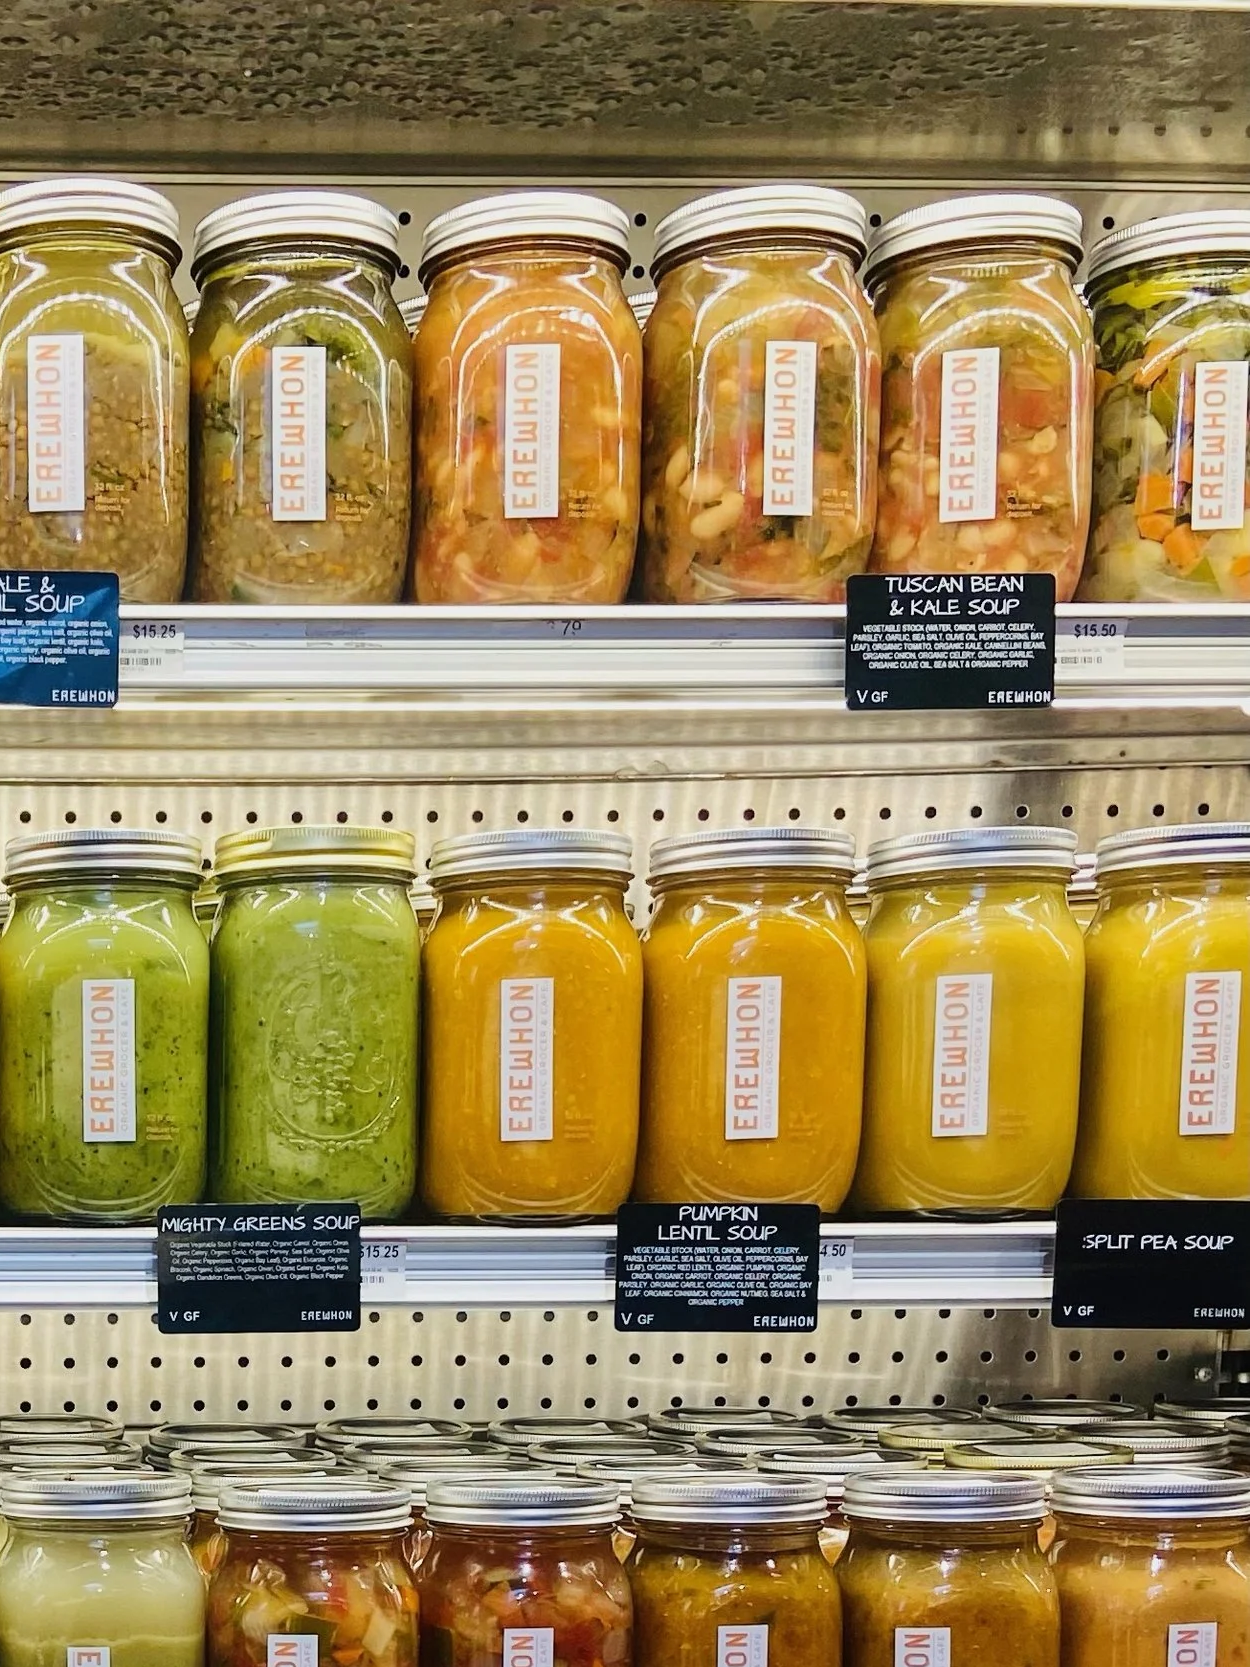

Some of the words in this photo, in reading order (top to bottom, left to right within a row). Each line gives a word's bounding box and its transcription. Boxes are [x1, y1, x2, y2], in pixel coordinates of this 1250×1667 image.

[511, 351, 539, 509] EREWHON
[1198, 367, 1229, 521] EREWHON
[39, 575, 56, 597] &
[884, 575, 964, 594] TUSCAN
[970, 575, 1024, 593] BEAN
[24, 594, 85, 614] SOUP
[889, 599, 904, 617] &
[910, 598, 961, 616] KALE
[967, 598, 1020, 616] SOUP
[132, 623, 176, 640] $15.25
[1073, 623, 1117, 639] $15.50
[52, 689, 116, 703] EREWHON
[988, 690, 1053, 706] EREWHON
[89, 985, 115, 1133] EREWHON
[1184, 977, 1220, 1126] EREWHON
[679, 1205, 759, 1222] PUMPKIN
[161, 1216, 227, 1234] MIGHTY
[233, 1215, 306, 1233] GREENS
[312, 1215, 360, 1231] SOUP
[657, 1224, 721, 1241] LENTIL
[726, 1225, 778, 1241] SOUP
[1140, 1234, 1178, 1251] PEA
[1183, 1235, 1235, 1250] SOUP
[1193, 1307, 1245, 1319] EREWHON
